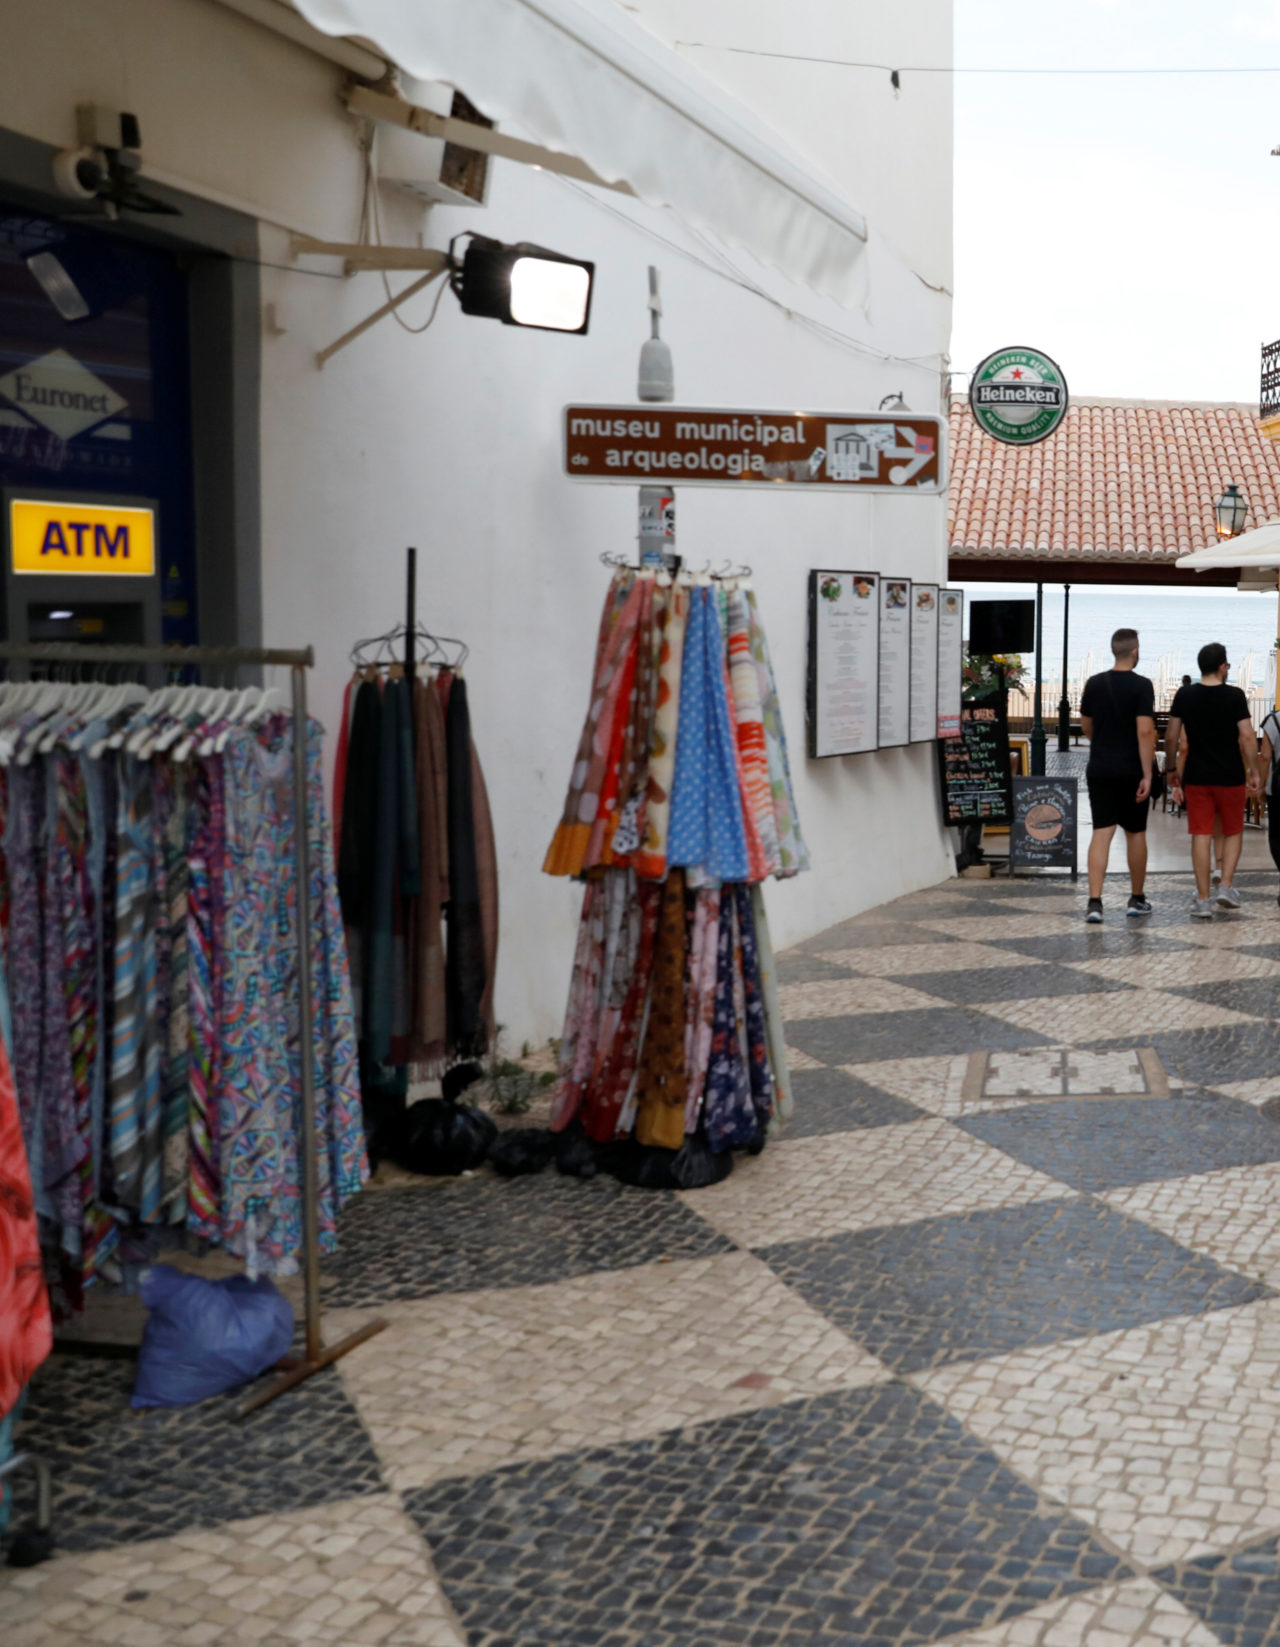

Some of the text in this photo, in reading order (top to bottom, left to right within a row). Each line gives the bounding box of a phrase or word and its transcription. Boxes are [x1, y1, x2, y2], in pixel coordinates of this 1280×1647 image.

[1029, 358, 1049, 375] BEER
[14, 373, 108, 413] Euronet
[980, 386, 1056, 403] Heineken
[571, 417, 806, 446] museu municipal
[1021, 413, 1051, 434] QUALITY
[571, 447, 766, 476] de arqueologia
[40, 520, 130, 559] ATM
